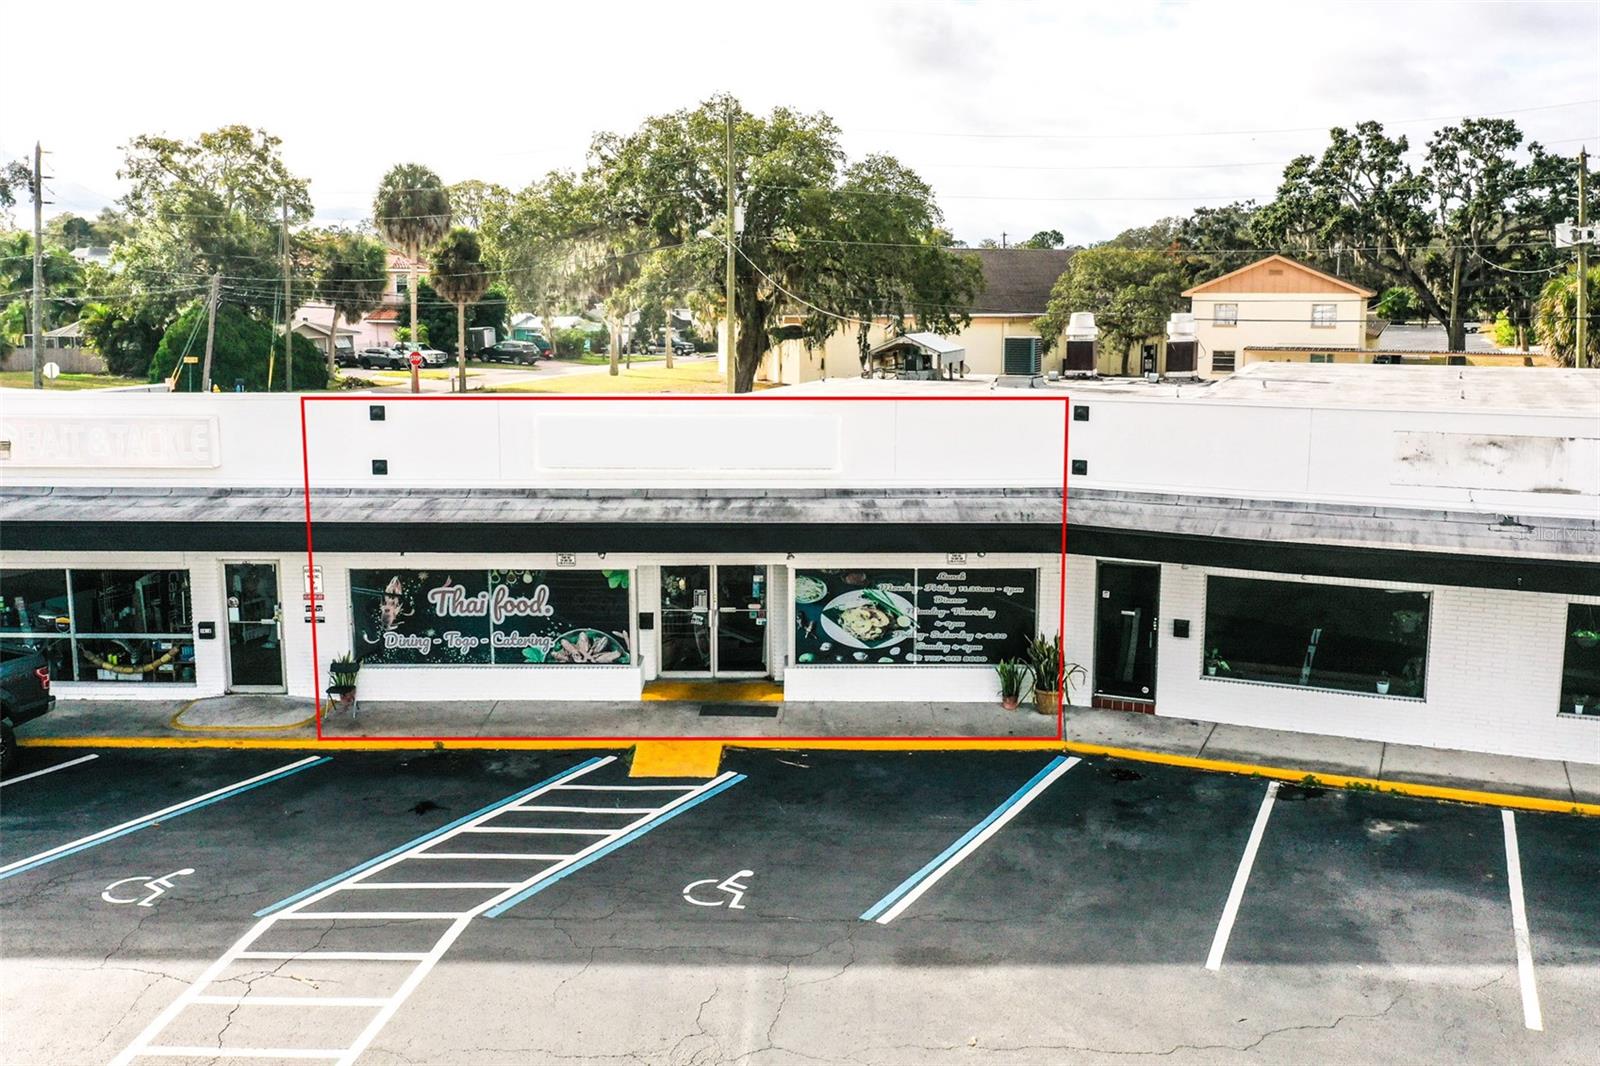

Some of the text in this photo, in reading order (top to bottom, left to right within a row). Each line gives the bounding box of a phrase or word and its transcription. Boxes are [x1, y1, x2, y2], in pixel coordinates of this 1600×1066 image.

[24, 424, 208, 461] BAIT & TACKLE
[936, 572, 966, 580] Lunch
[428, 585, 554, 624] Thai food.
[933, 595, 968, 604] Dinner
[951, 606, 996, 619] Thursday
[930, 630, 974, 642] Saturday
[384, 631, 432, 655] Dining
[443, 631, 478, 654] Togo
[915, 641, 951, 653] Sunday
